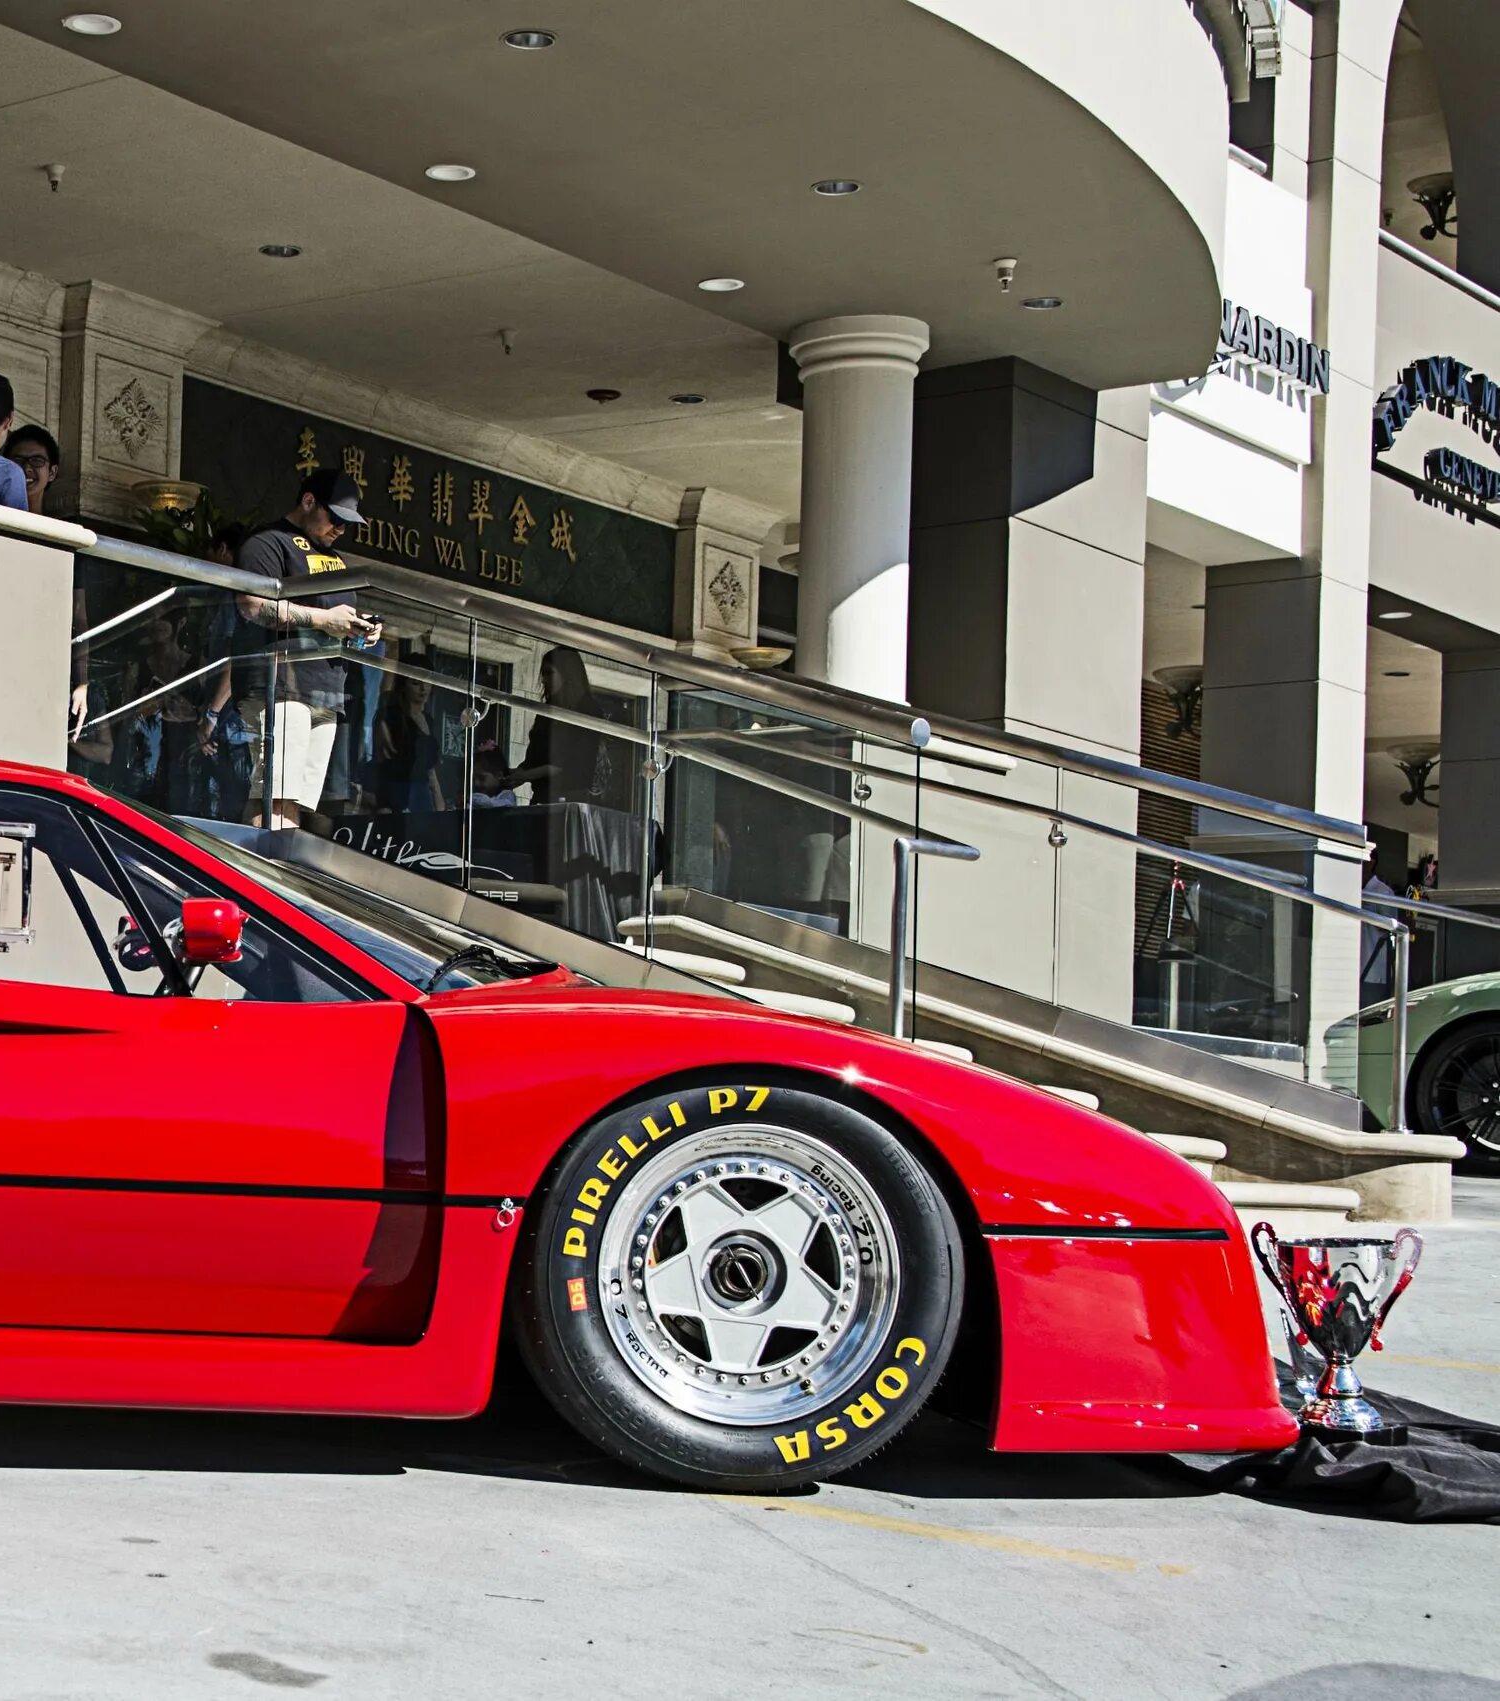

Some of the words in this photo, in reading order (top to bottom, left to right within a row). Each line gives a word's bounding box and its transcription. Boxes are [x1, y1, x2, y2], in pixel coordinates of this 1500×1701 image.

[354, 516, 421, 559] HING
[434, 536, 467, 572] WA
[479, 549, 525, 586] LEE
[562, 1102, 687, 1258] PIRELLI
[708, 1086, 771, 1114] P7
[810, 1164, 857, 1213] Racing
[772, 1337, 928, 1465] CORSA
